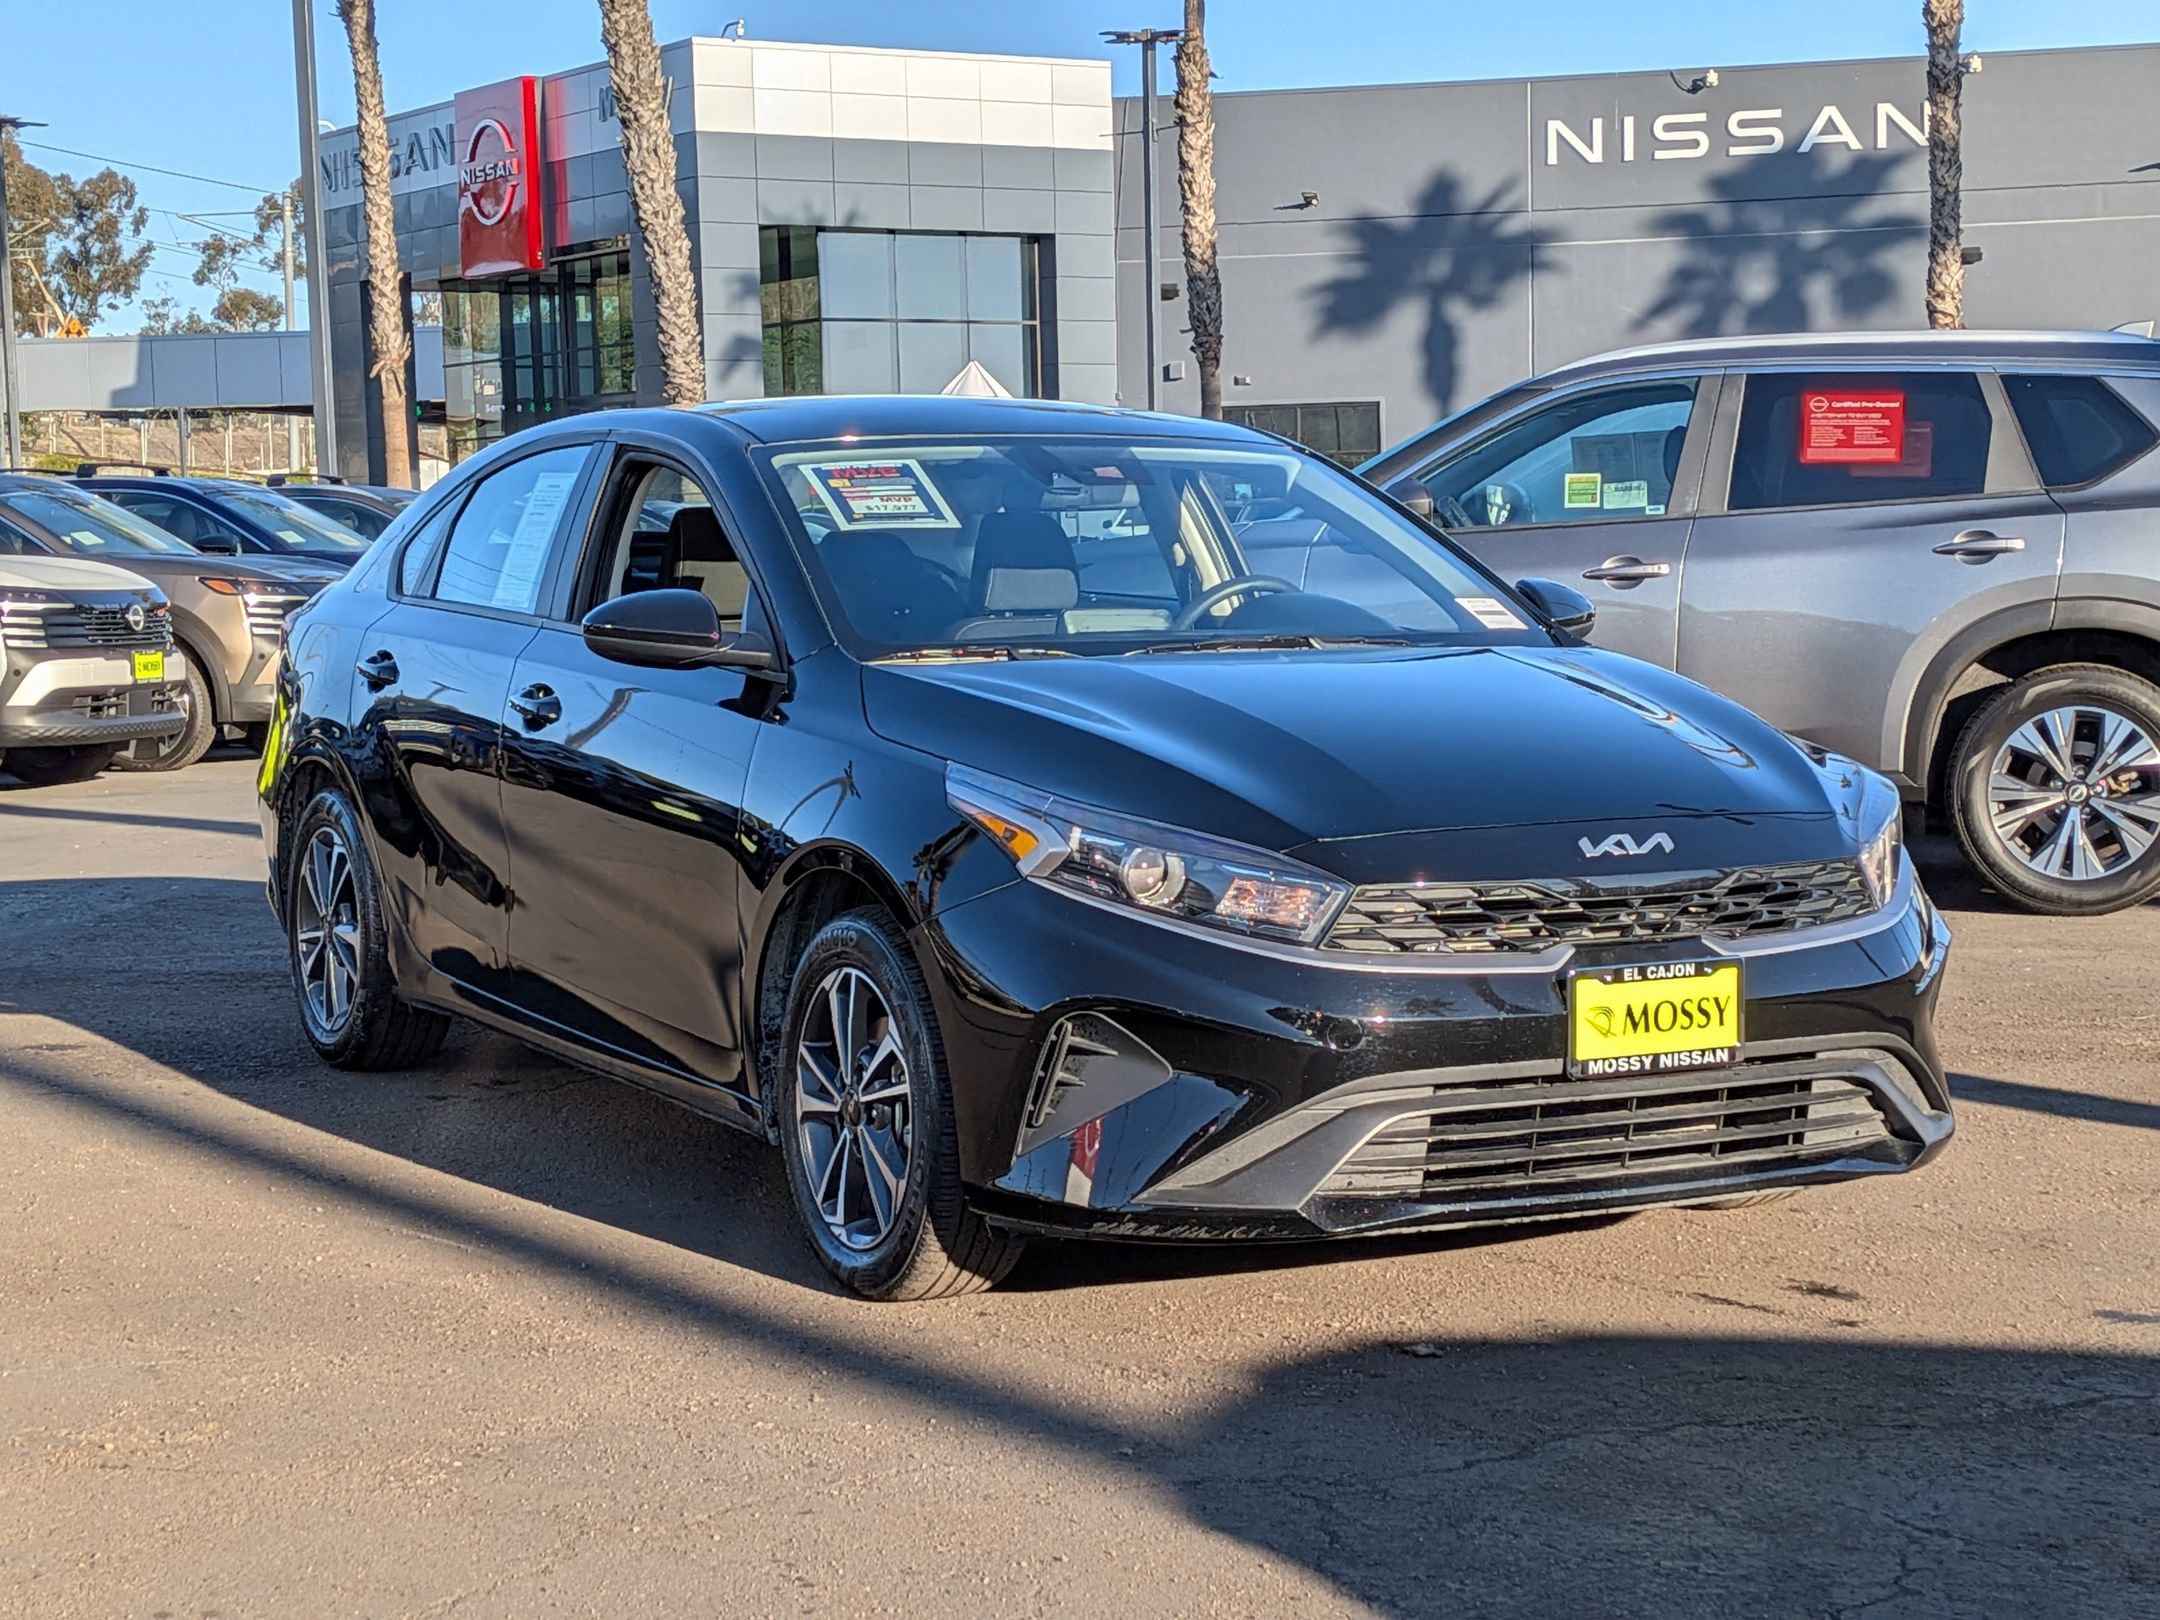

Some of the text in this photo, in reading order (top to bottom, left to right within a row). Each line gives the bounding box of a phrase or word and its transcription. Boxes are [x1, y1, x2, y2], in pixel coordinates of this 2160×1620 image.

[1546, 101, 1930, 165] NISSAN
[461, 158, 520, 187] NISSAN
[1577, 832, 1675, 857] KIA
[1623, 963, 1696, 981] EL CAJON
[1622, 995, 1731, 1035] MOSSY
[1588, 1048, 1729, 1075] MOSSY NISSAN
